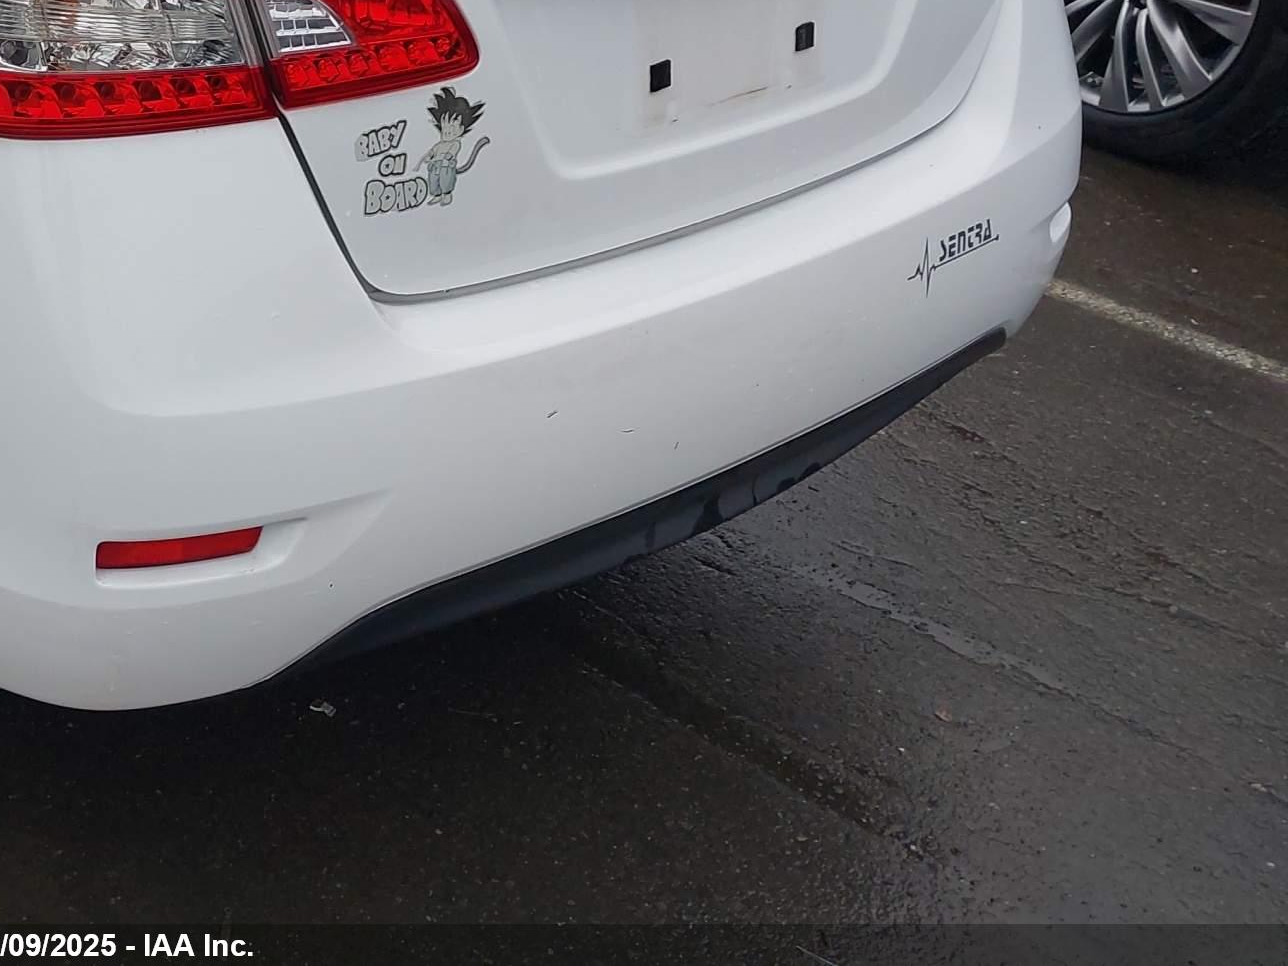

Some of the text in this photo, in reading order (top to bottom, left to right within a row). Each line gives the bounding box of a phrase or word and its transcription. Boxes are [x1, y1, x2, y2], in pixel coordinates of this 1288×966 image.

[354, 120, 407, 162] BABY
[378, 153, 408, 176] ON
[364, 176, 428, 215] BOARD
